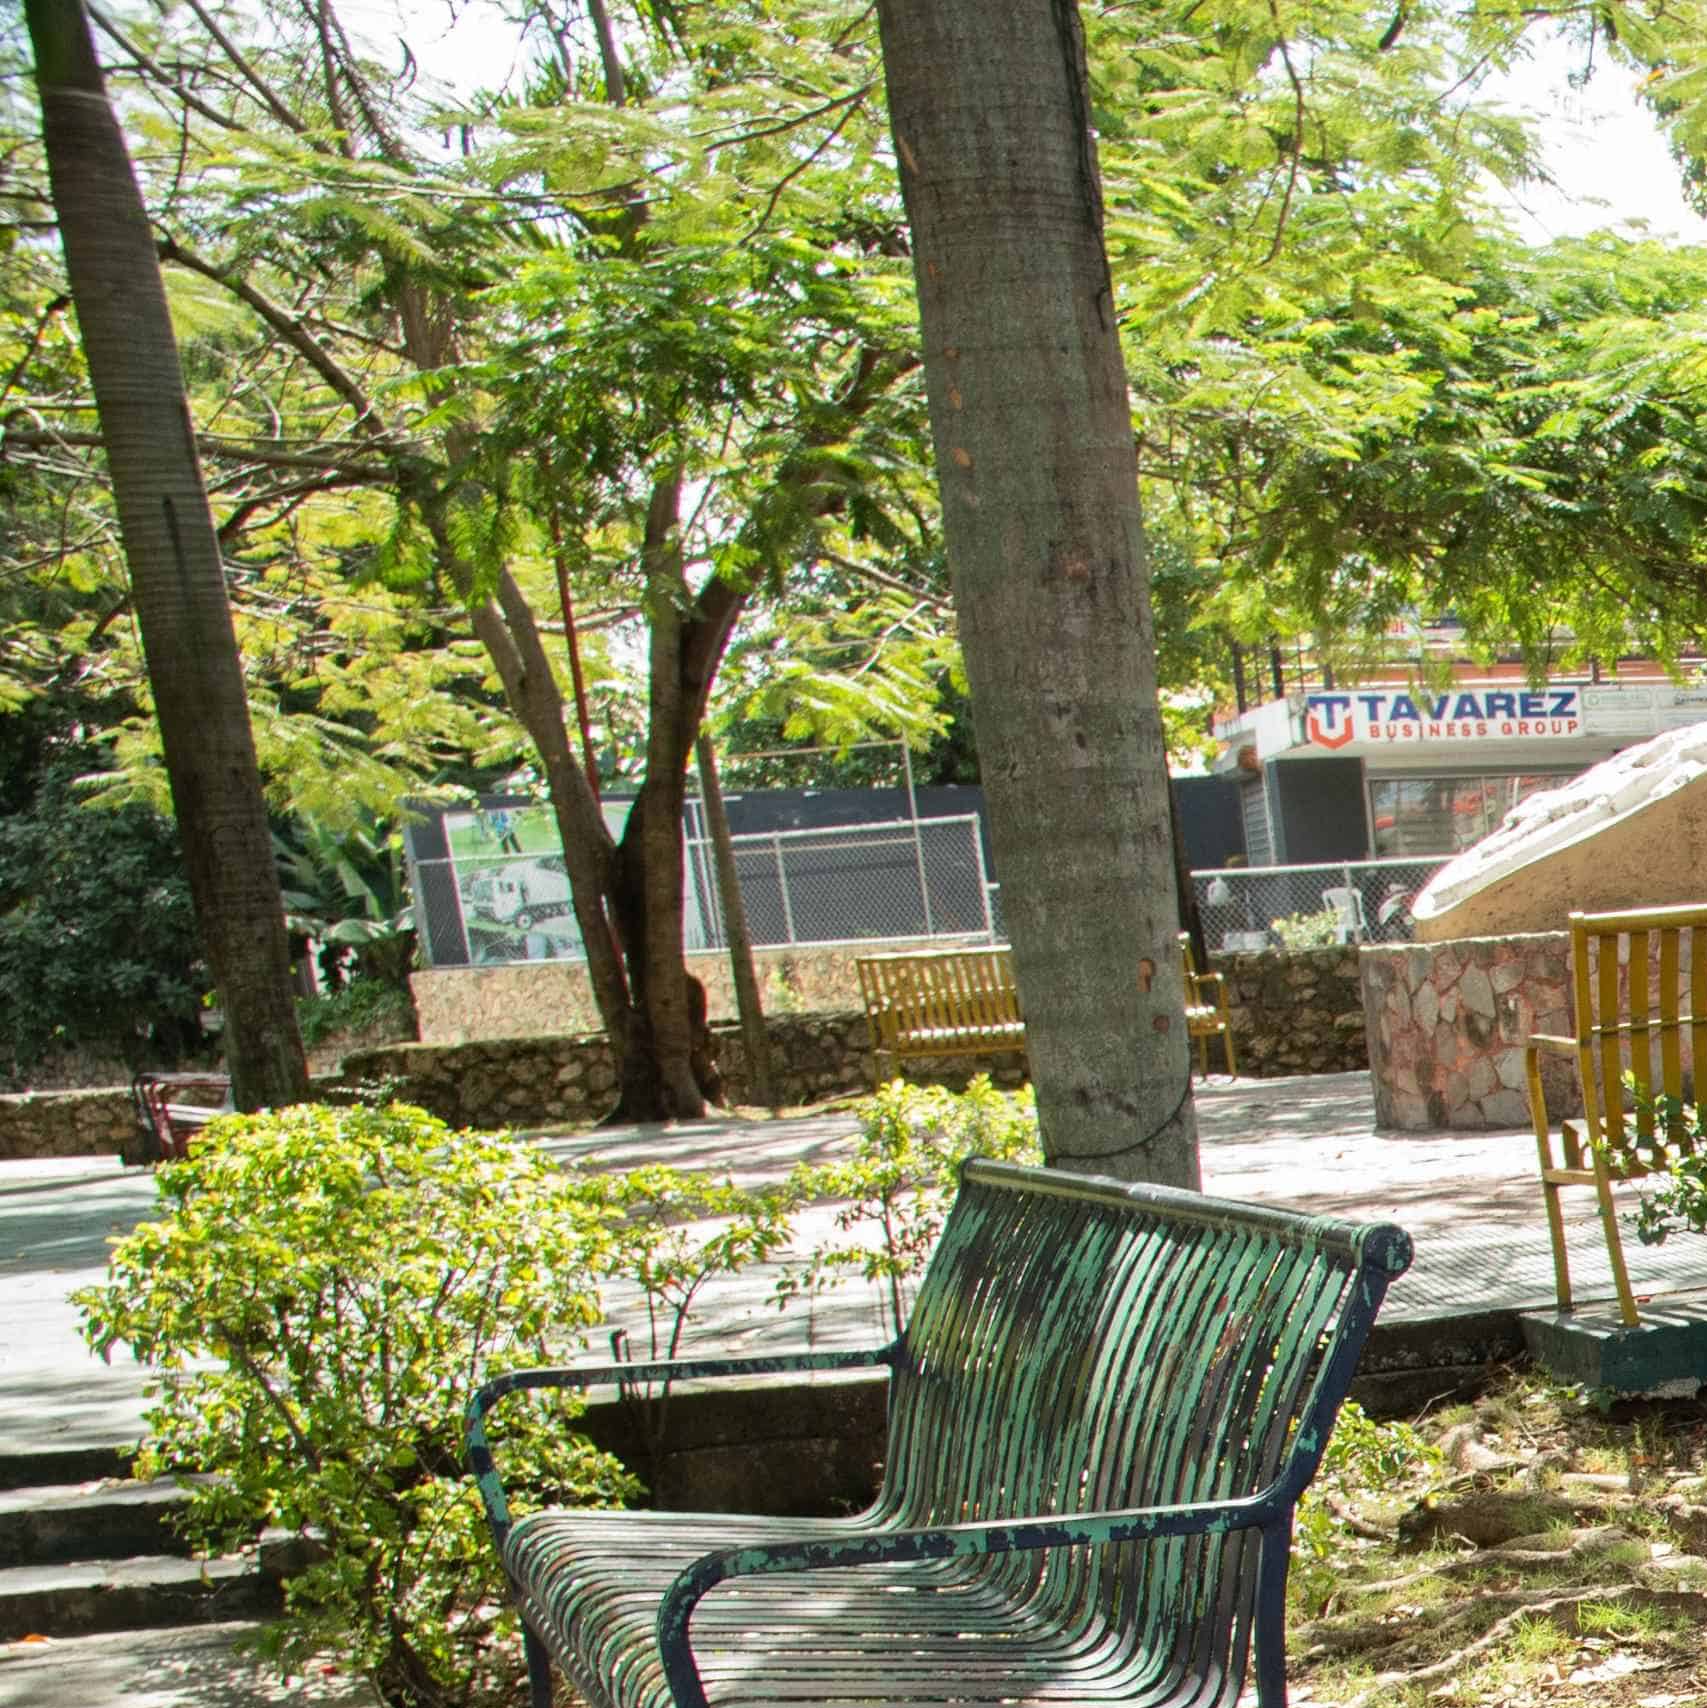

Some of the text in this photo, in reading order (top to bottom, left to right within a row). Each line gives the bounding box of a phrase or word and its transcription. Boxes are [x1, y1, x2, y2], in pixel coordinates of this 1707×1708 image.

[1358, 691, 1578, 721] TAVAREZ
[1369, 719, 1487, 739] BUSINESS
[1501, 718, 1579, 736] GROUP
